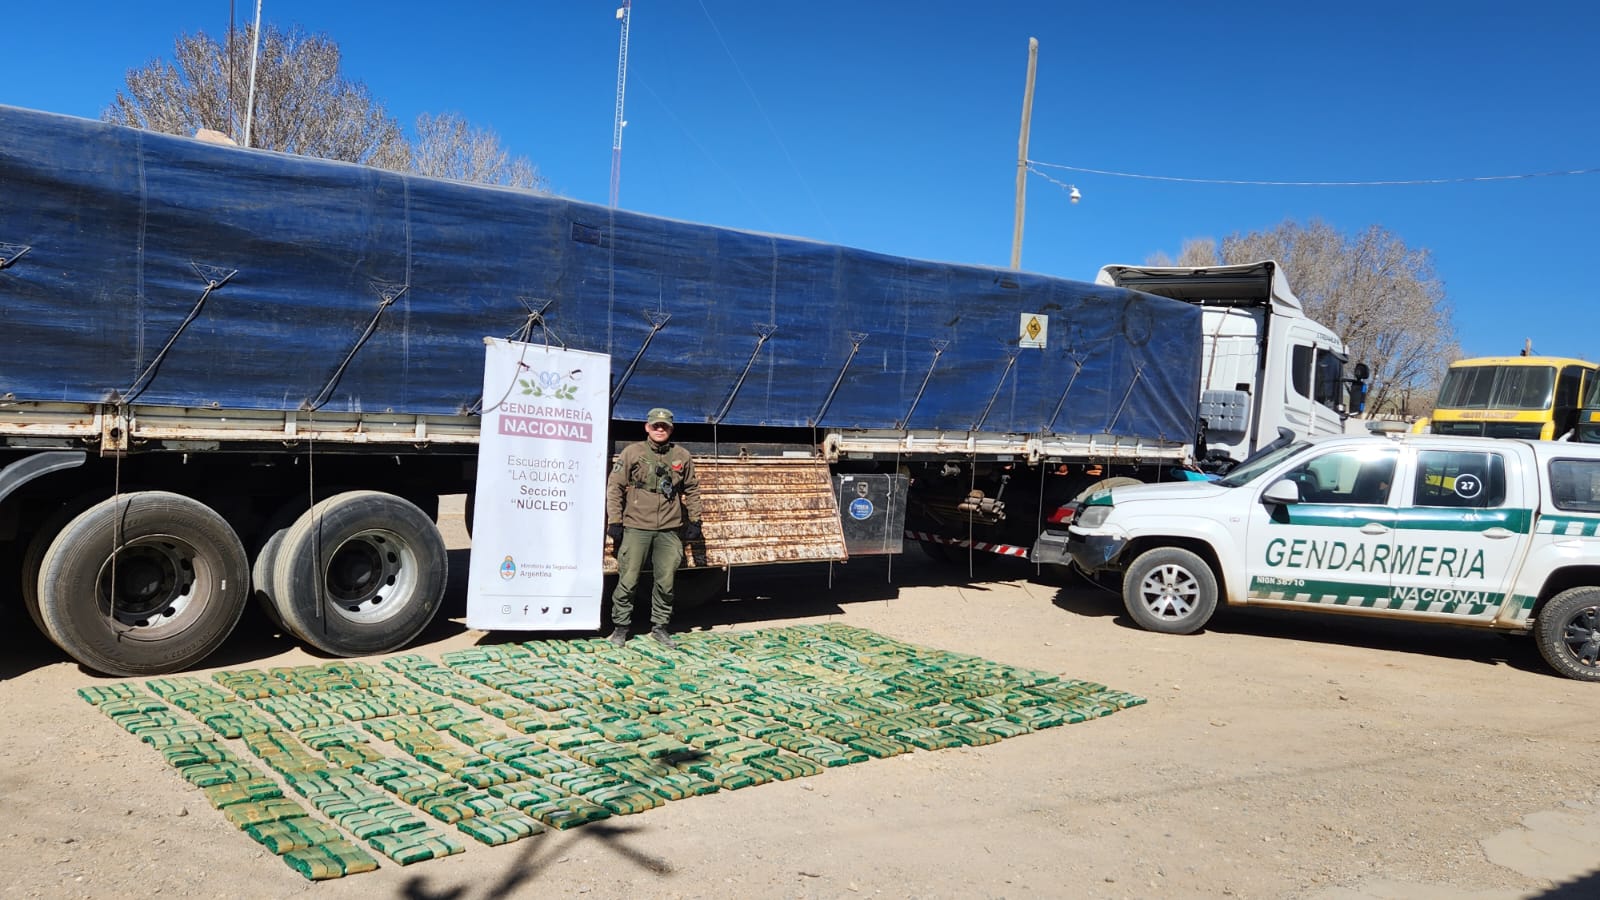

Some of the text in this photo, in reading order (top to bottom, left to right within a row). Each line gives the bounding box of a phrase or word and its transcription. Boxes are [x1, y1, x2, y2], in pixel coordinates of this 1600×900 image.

[500, 402, 592, 421] GENDARMERÍA
[504, 418, 588, 440] NACIONAL
[507, 455, 580, 470] Escuadrón 21
[520, 484, 567, 497] Sección
[1461, 481, 1475, 490] 27
[1265, 537, 1485, 579] GENDARMERIA
[1393, 586, 1494, 605] NACIONAL
